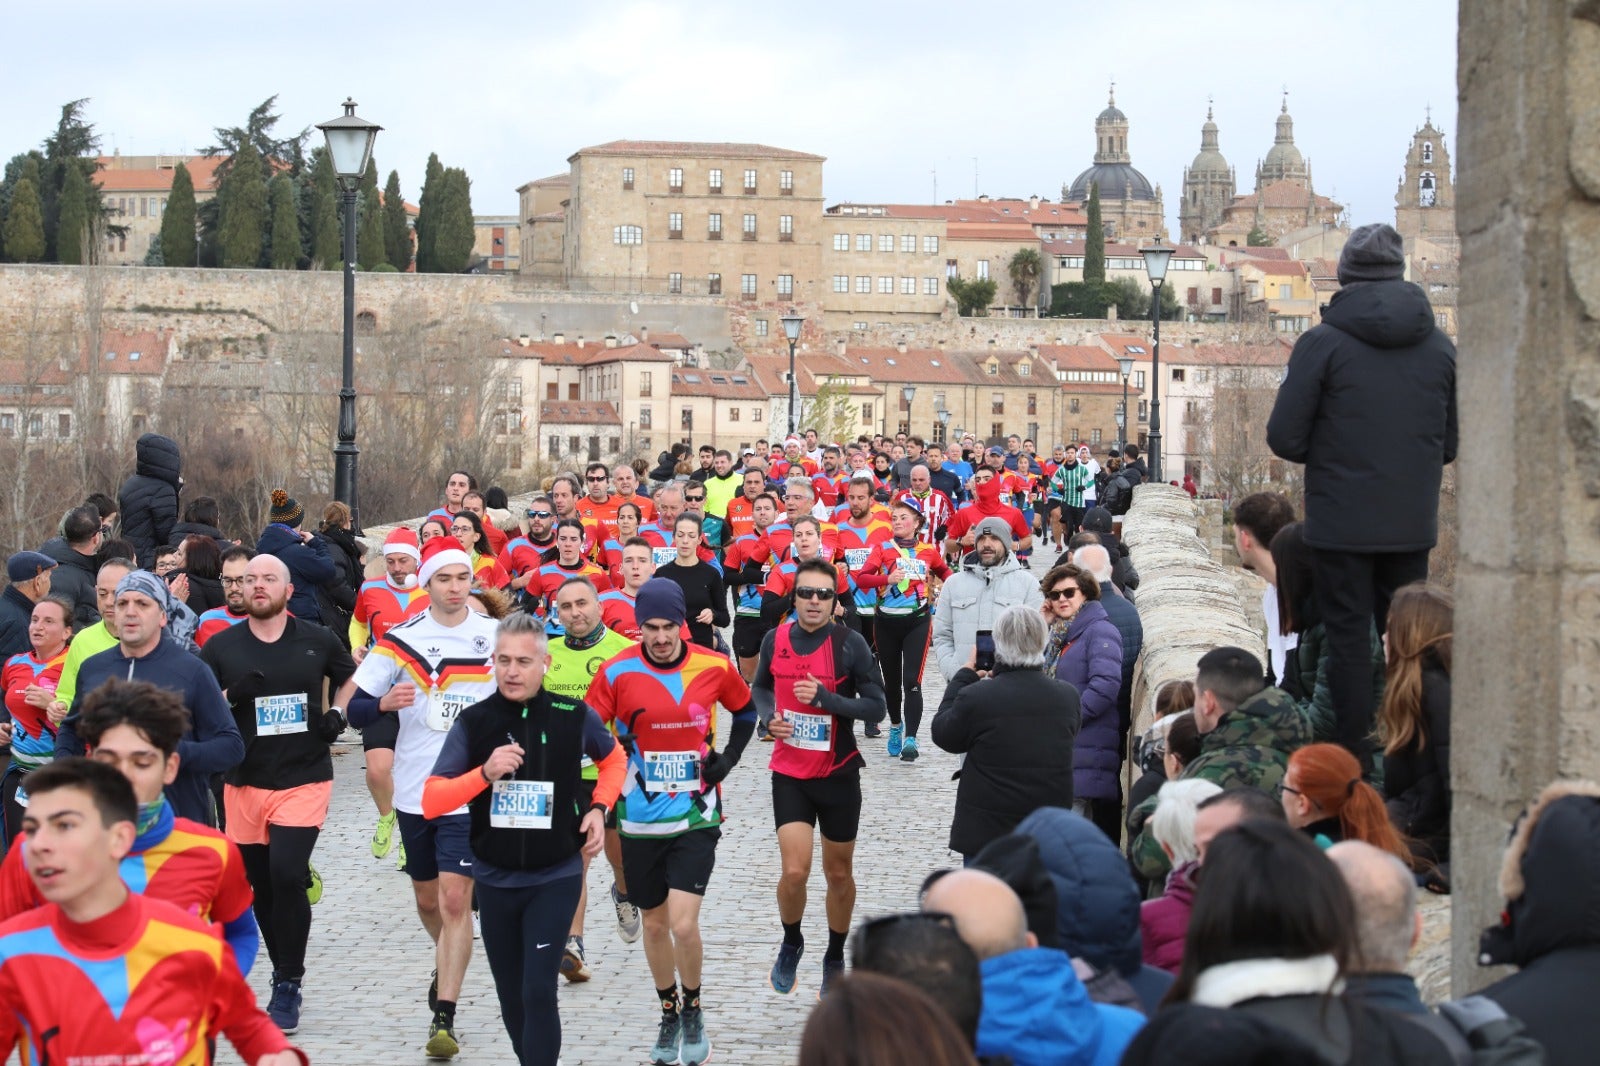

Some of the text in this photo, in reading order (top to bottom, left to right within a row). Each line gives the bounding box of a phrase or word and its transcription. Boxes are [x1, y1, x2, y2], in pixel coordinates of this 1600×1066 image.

[270, 696, 303, 705] SETEL
[444, 694, 478, 703] SETEL
[263, 704, 296, 723] 3726
[795, 714, 827, 723] SETEL
[789, 720, 819, 738] 583
[654, 762, 686, 779] 4016
[507, 783, 547, 793] SETEL
[498, 793, 538, 812] 5303
